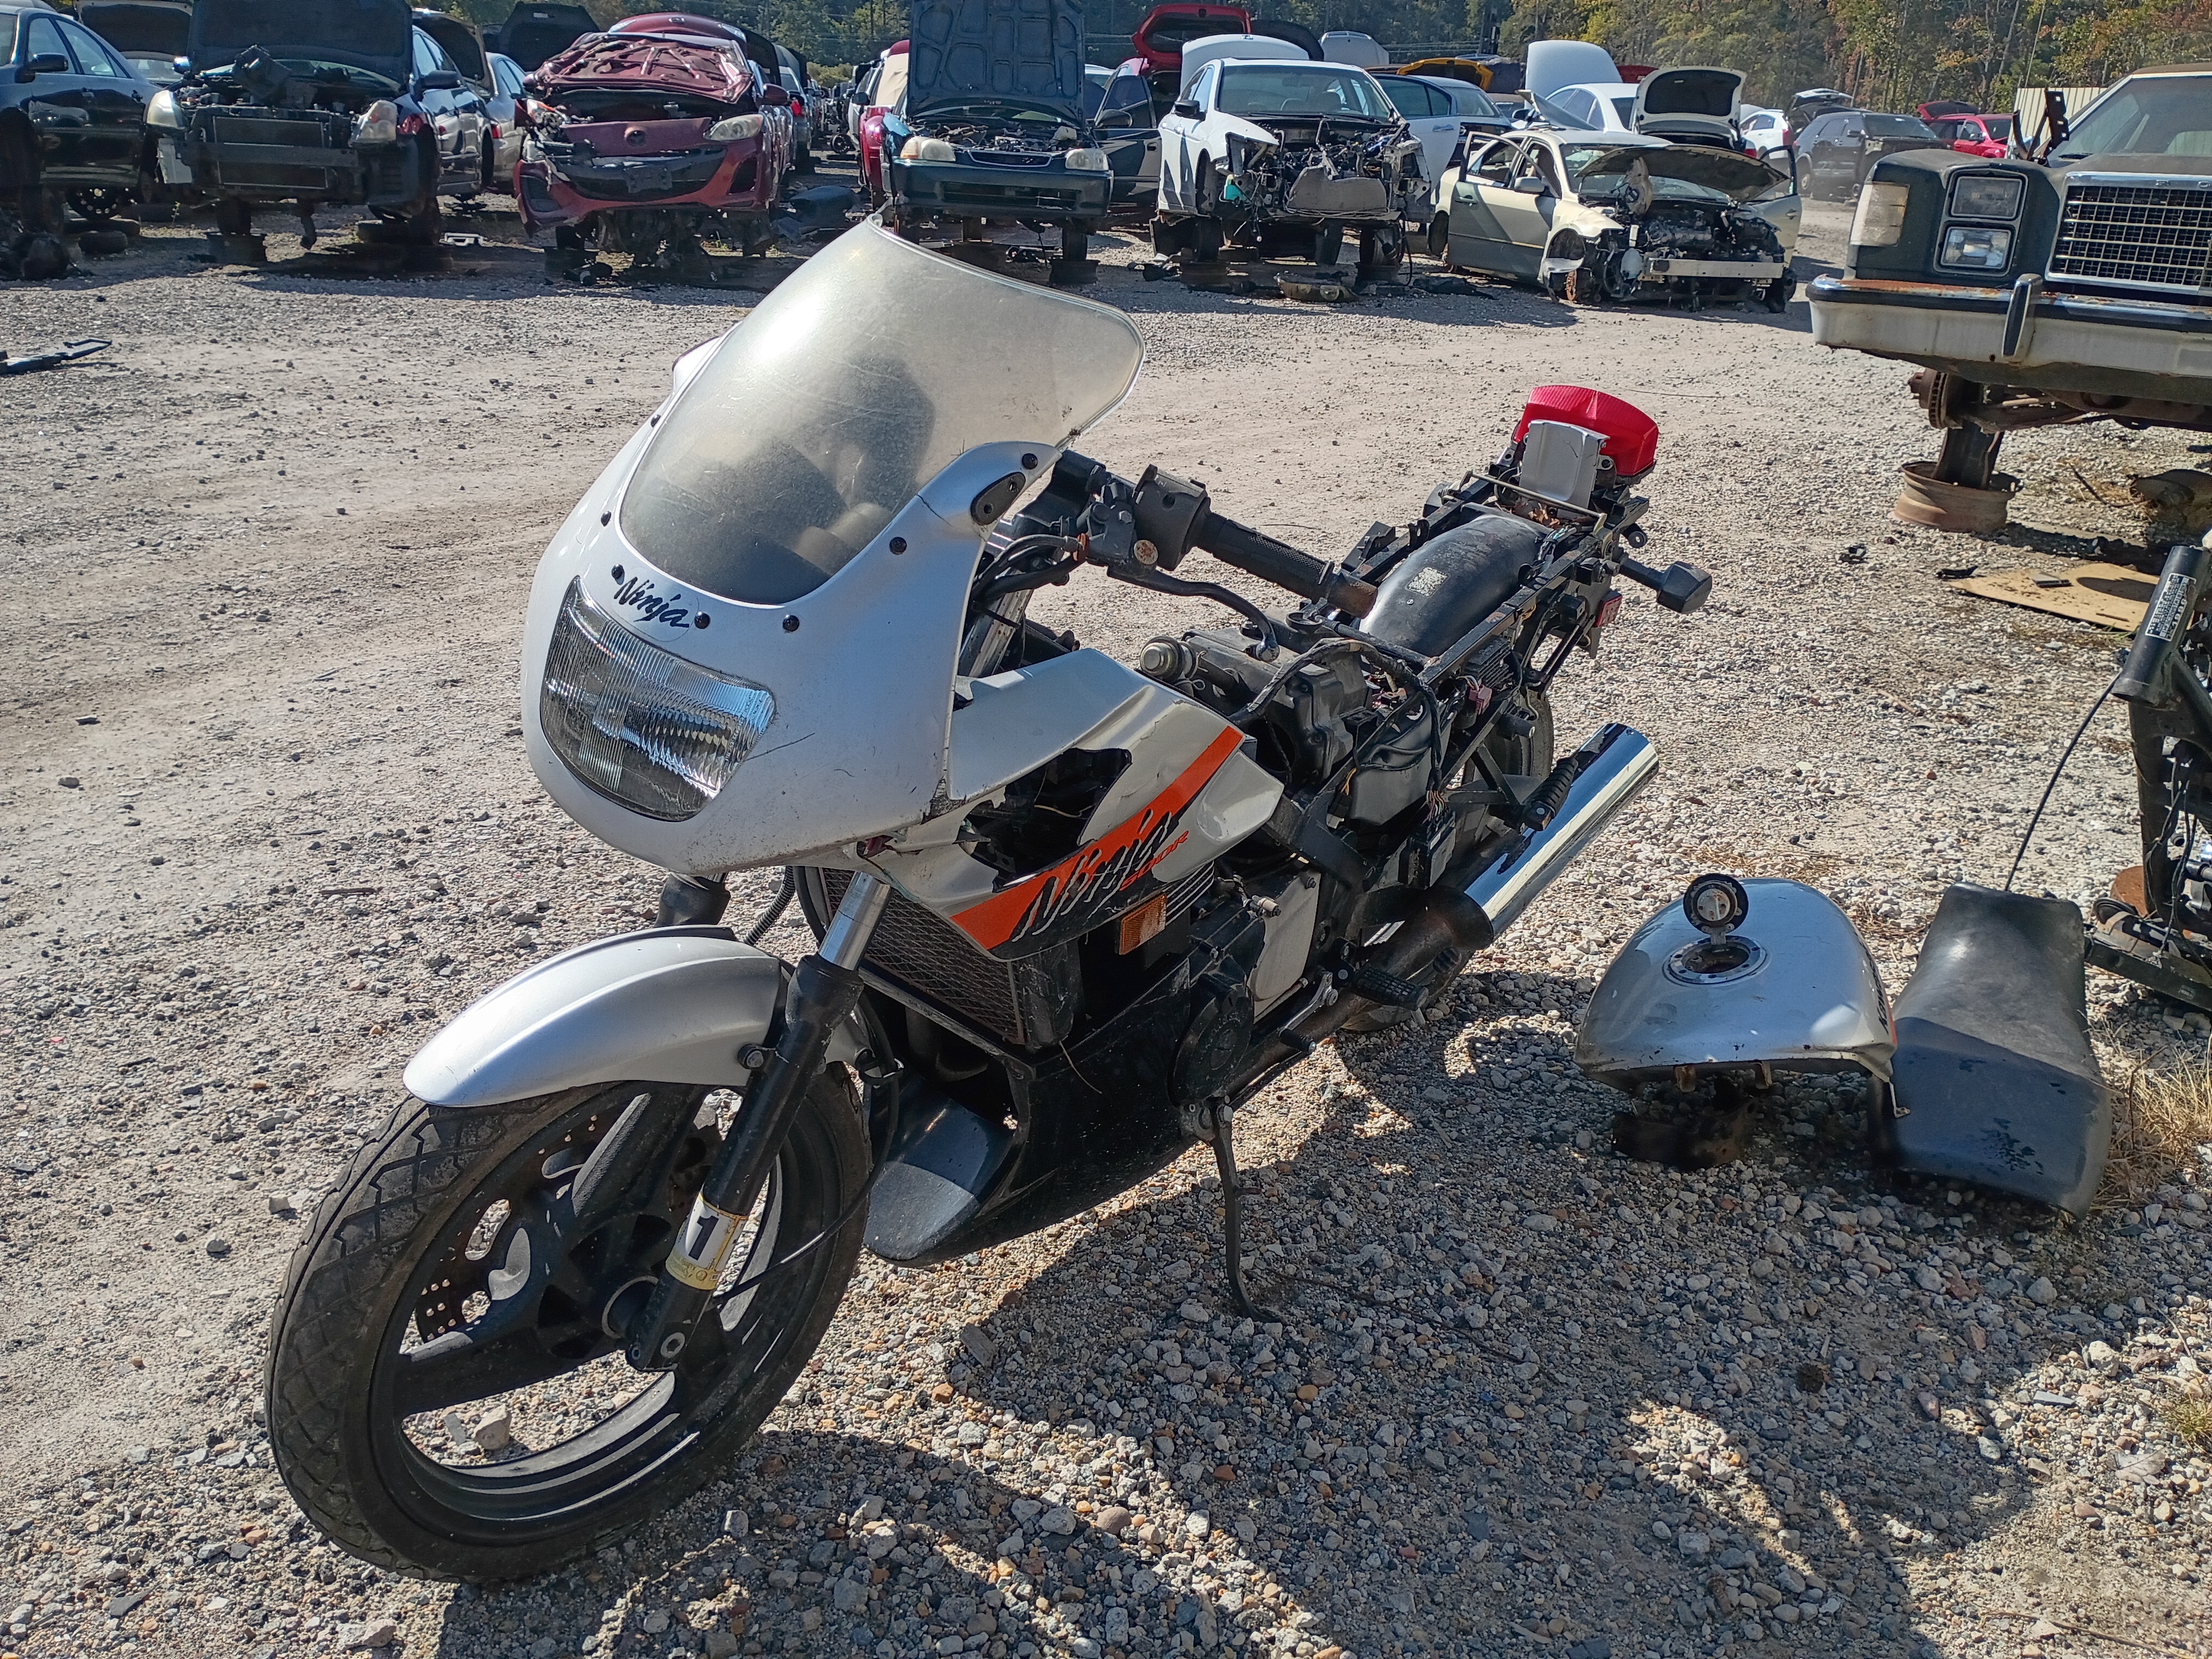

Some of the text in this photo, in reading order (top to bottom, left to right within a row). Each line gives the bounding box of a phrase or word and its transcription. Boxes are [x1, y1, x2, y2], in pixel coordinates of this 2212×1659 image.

[614, 576, 690, 628] Ninja
[1010, 808, 1172, 942] Ninja
[1118, 830, 1189, 891] 500R
[688, 1215, 719, 1261] 1
